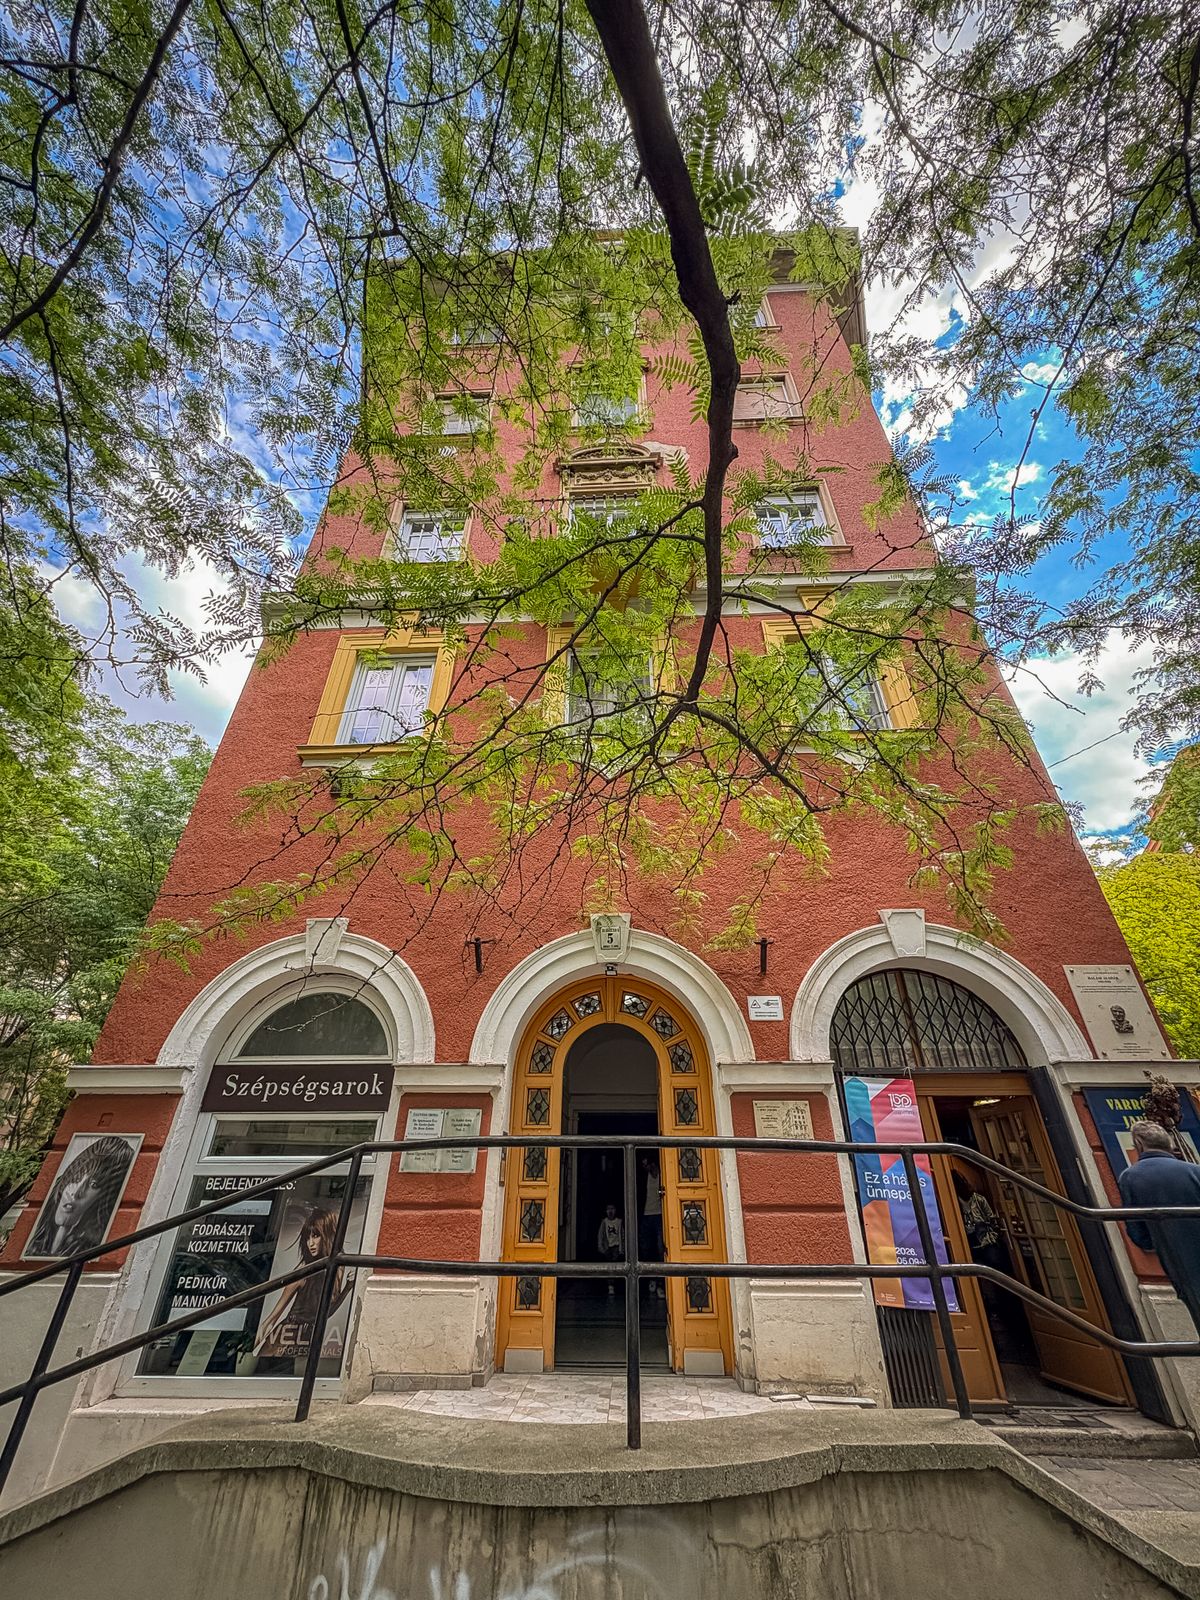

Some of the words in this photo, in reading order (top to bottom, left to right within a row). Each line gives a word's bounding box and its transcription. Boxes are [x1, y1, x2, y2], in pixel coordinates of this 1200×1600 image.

[607, 933, 613, 944] 5
[222, 1073, 384, 1102] Szépségsarok
[864, 1172, 880, 1184] Ez
[882, 1175, 890, 1185] a
[892, 1173, 909, 1186] há
[866, 1185, 912, 1202] ünnepe
[191, 1222, 254, 1236] FODRÁSZAT
[187, 1240, 250, 1253] KOZMETIKA
[895, 1247, 917, 1256] 2026.
[177, 1275, 227, 1289] PEDIKŰR
[262, 1323, 343, 1346] WELA
[277, 1346, 342, 1356] PROFESNALS
